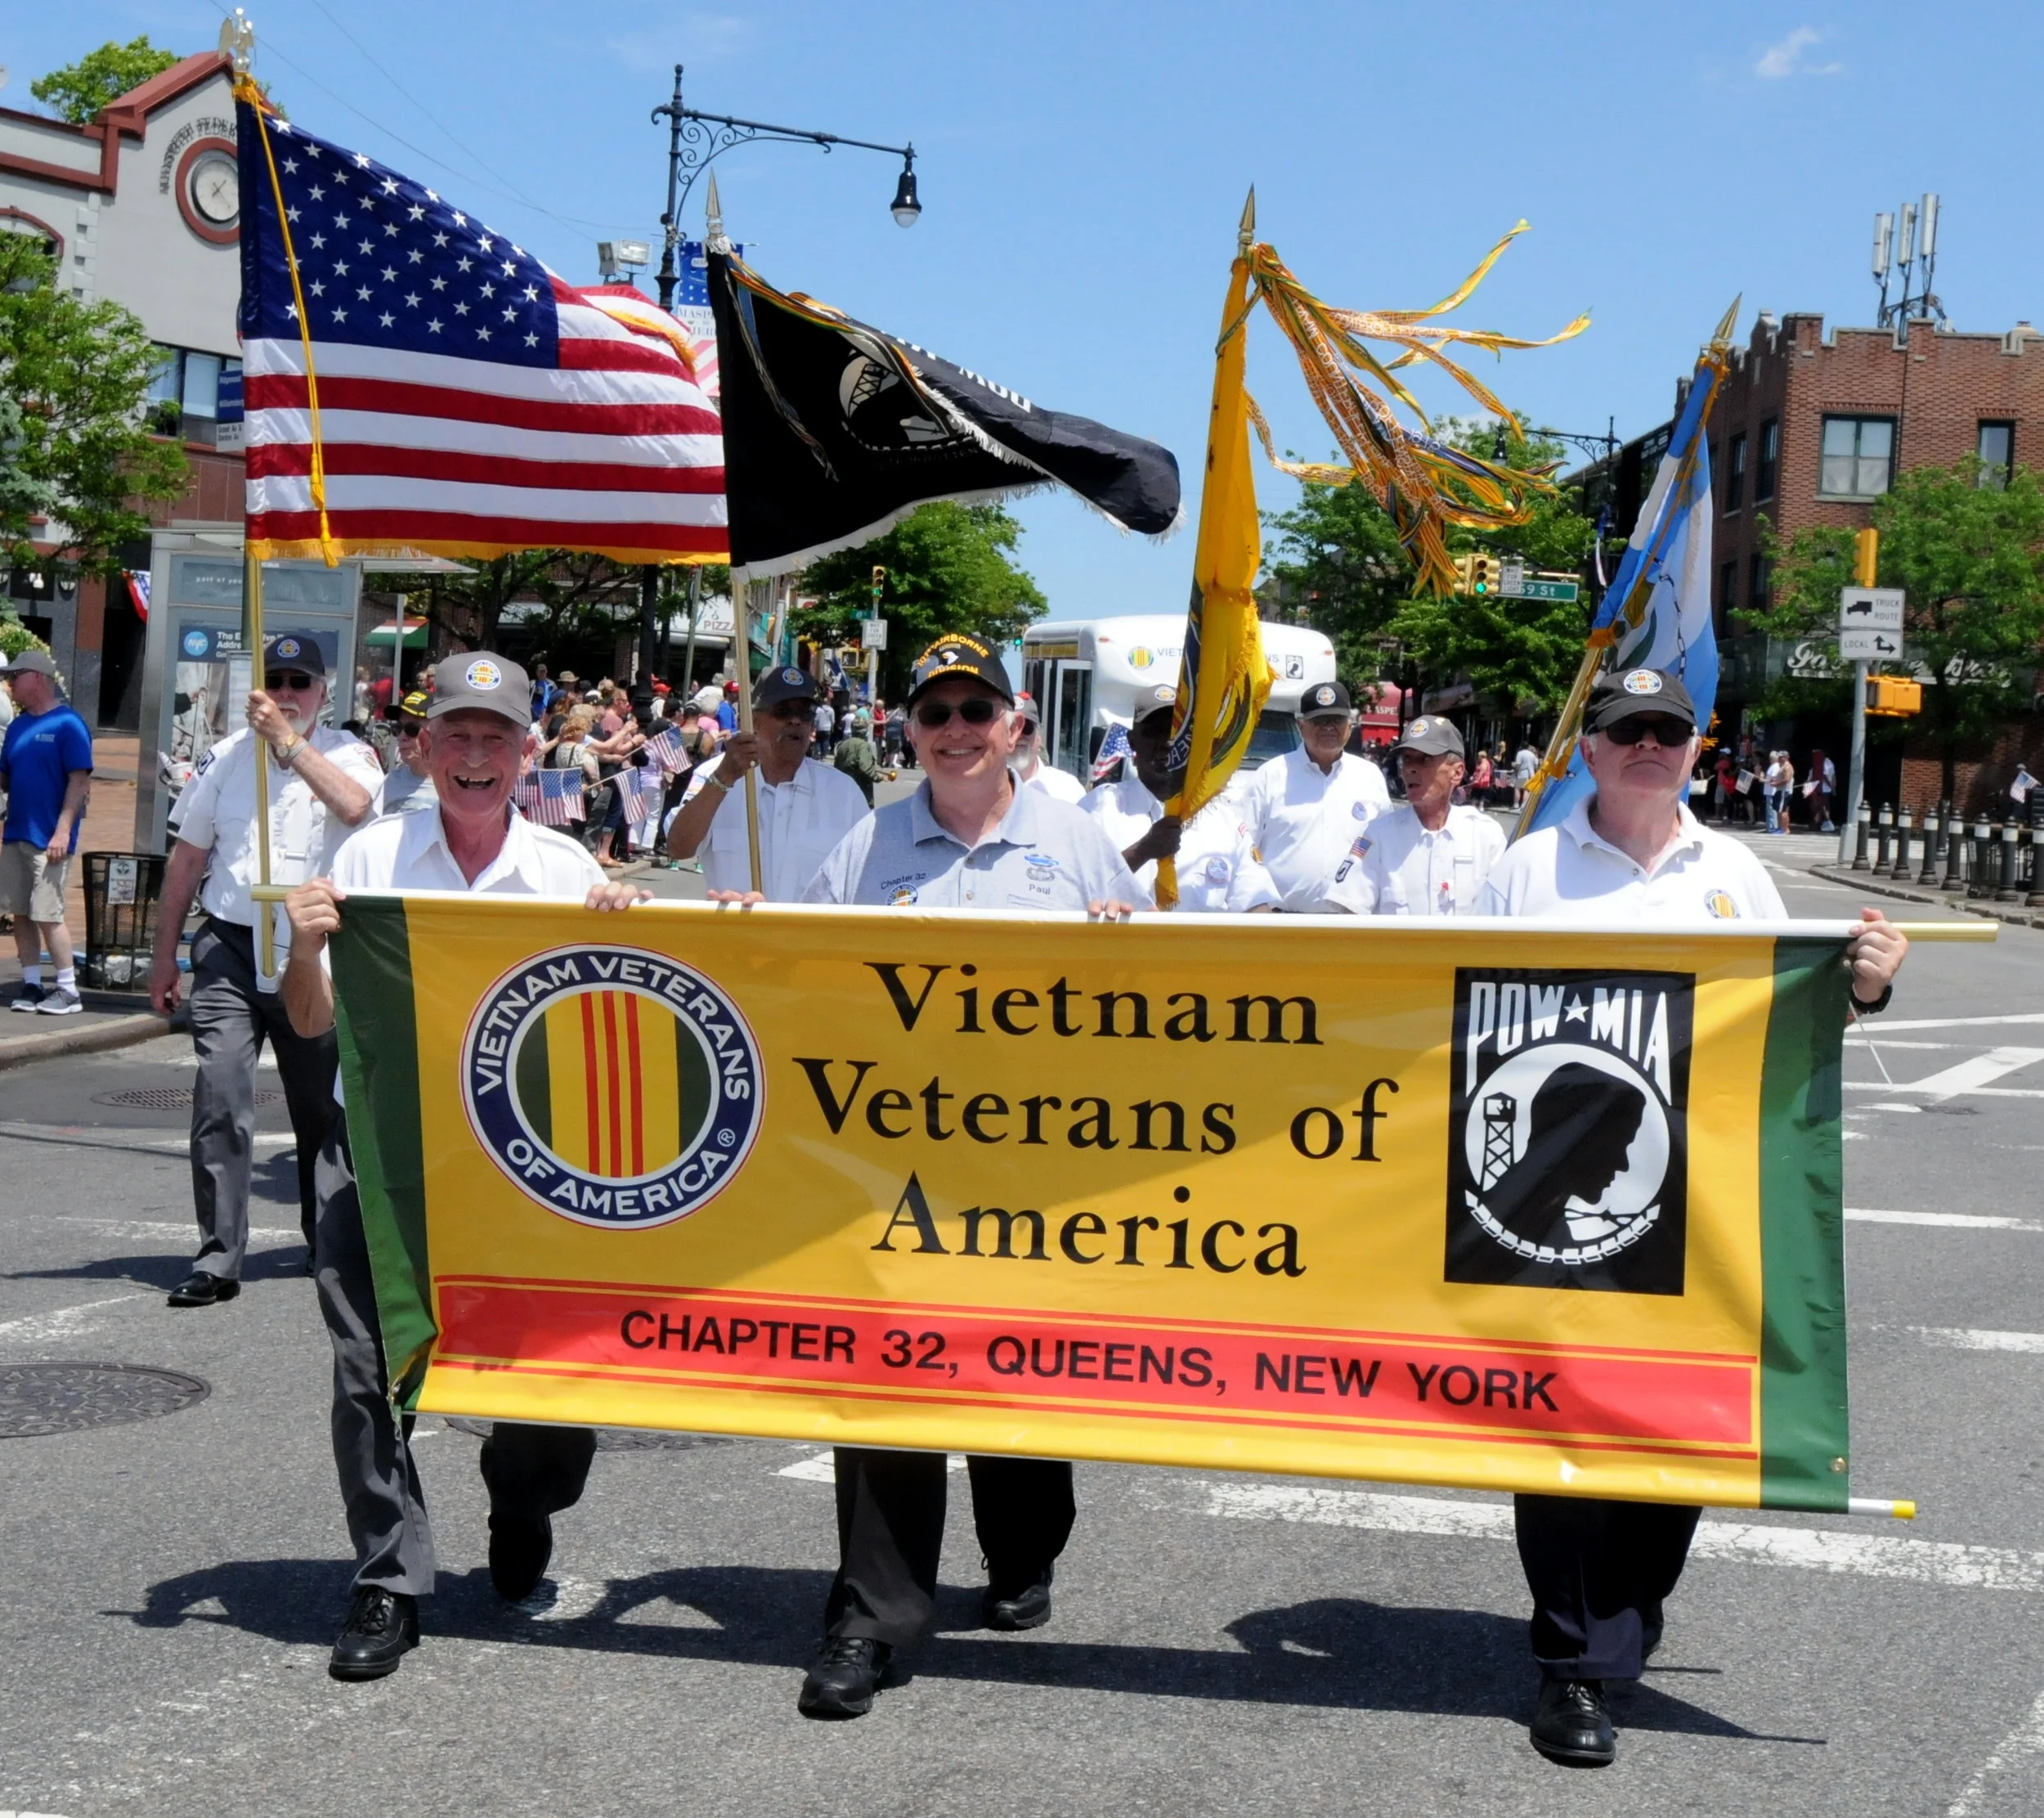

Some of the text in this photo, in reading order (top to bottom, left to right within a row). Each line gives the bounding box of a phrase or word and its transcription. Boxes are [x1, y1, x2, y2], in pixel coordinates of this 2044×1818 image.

[678, 307, 715, 321] MASP
[227, 577, 243, 586] you
[1540, 585, 1556, 596] St
[1875, 599, 1900, 608] TRUCK
[1874, 612, 1899, 621] ROUTE
[217, 631, 234, 640] The
[216, 640, 242, 649] Addre
[933, 634, 989, 658] AIRBORNE
[1844, 640, 1869, 649] LOCAL
[1157, 647, 1185, 658] VIET
[881, 873, 926, 890] Chapter 32
[1029, 883, 1051, 896] Paul
[863, 961, 1325, 1046] Vietnam
[477, 959, 581, 1096] VIETNAM
[588, 955, 750, 1101] VETERANS
[1465, 981, 1672, 1107] POW MIA
[791, 1057, 1400, 1162] Veterans of
[507, 1138, 556, 1179] OF
[870, 1169, 1307, 1278] America
[620, 1309, 1560, 1412] CHAPTER 32, QUEENS, NEW YORK
